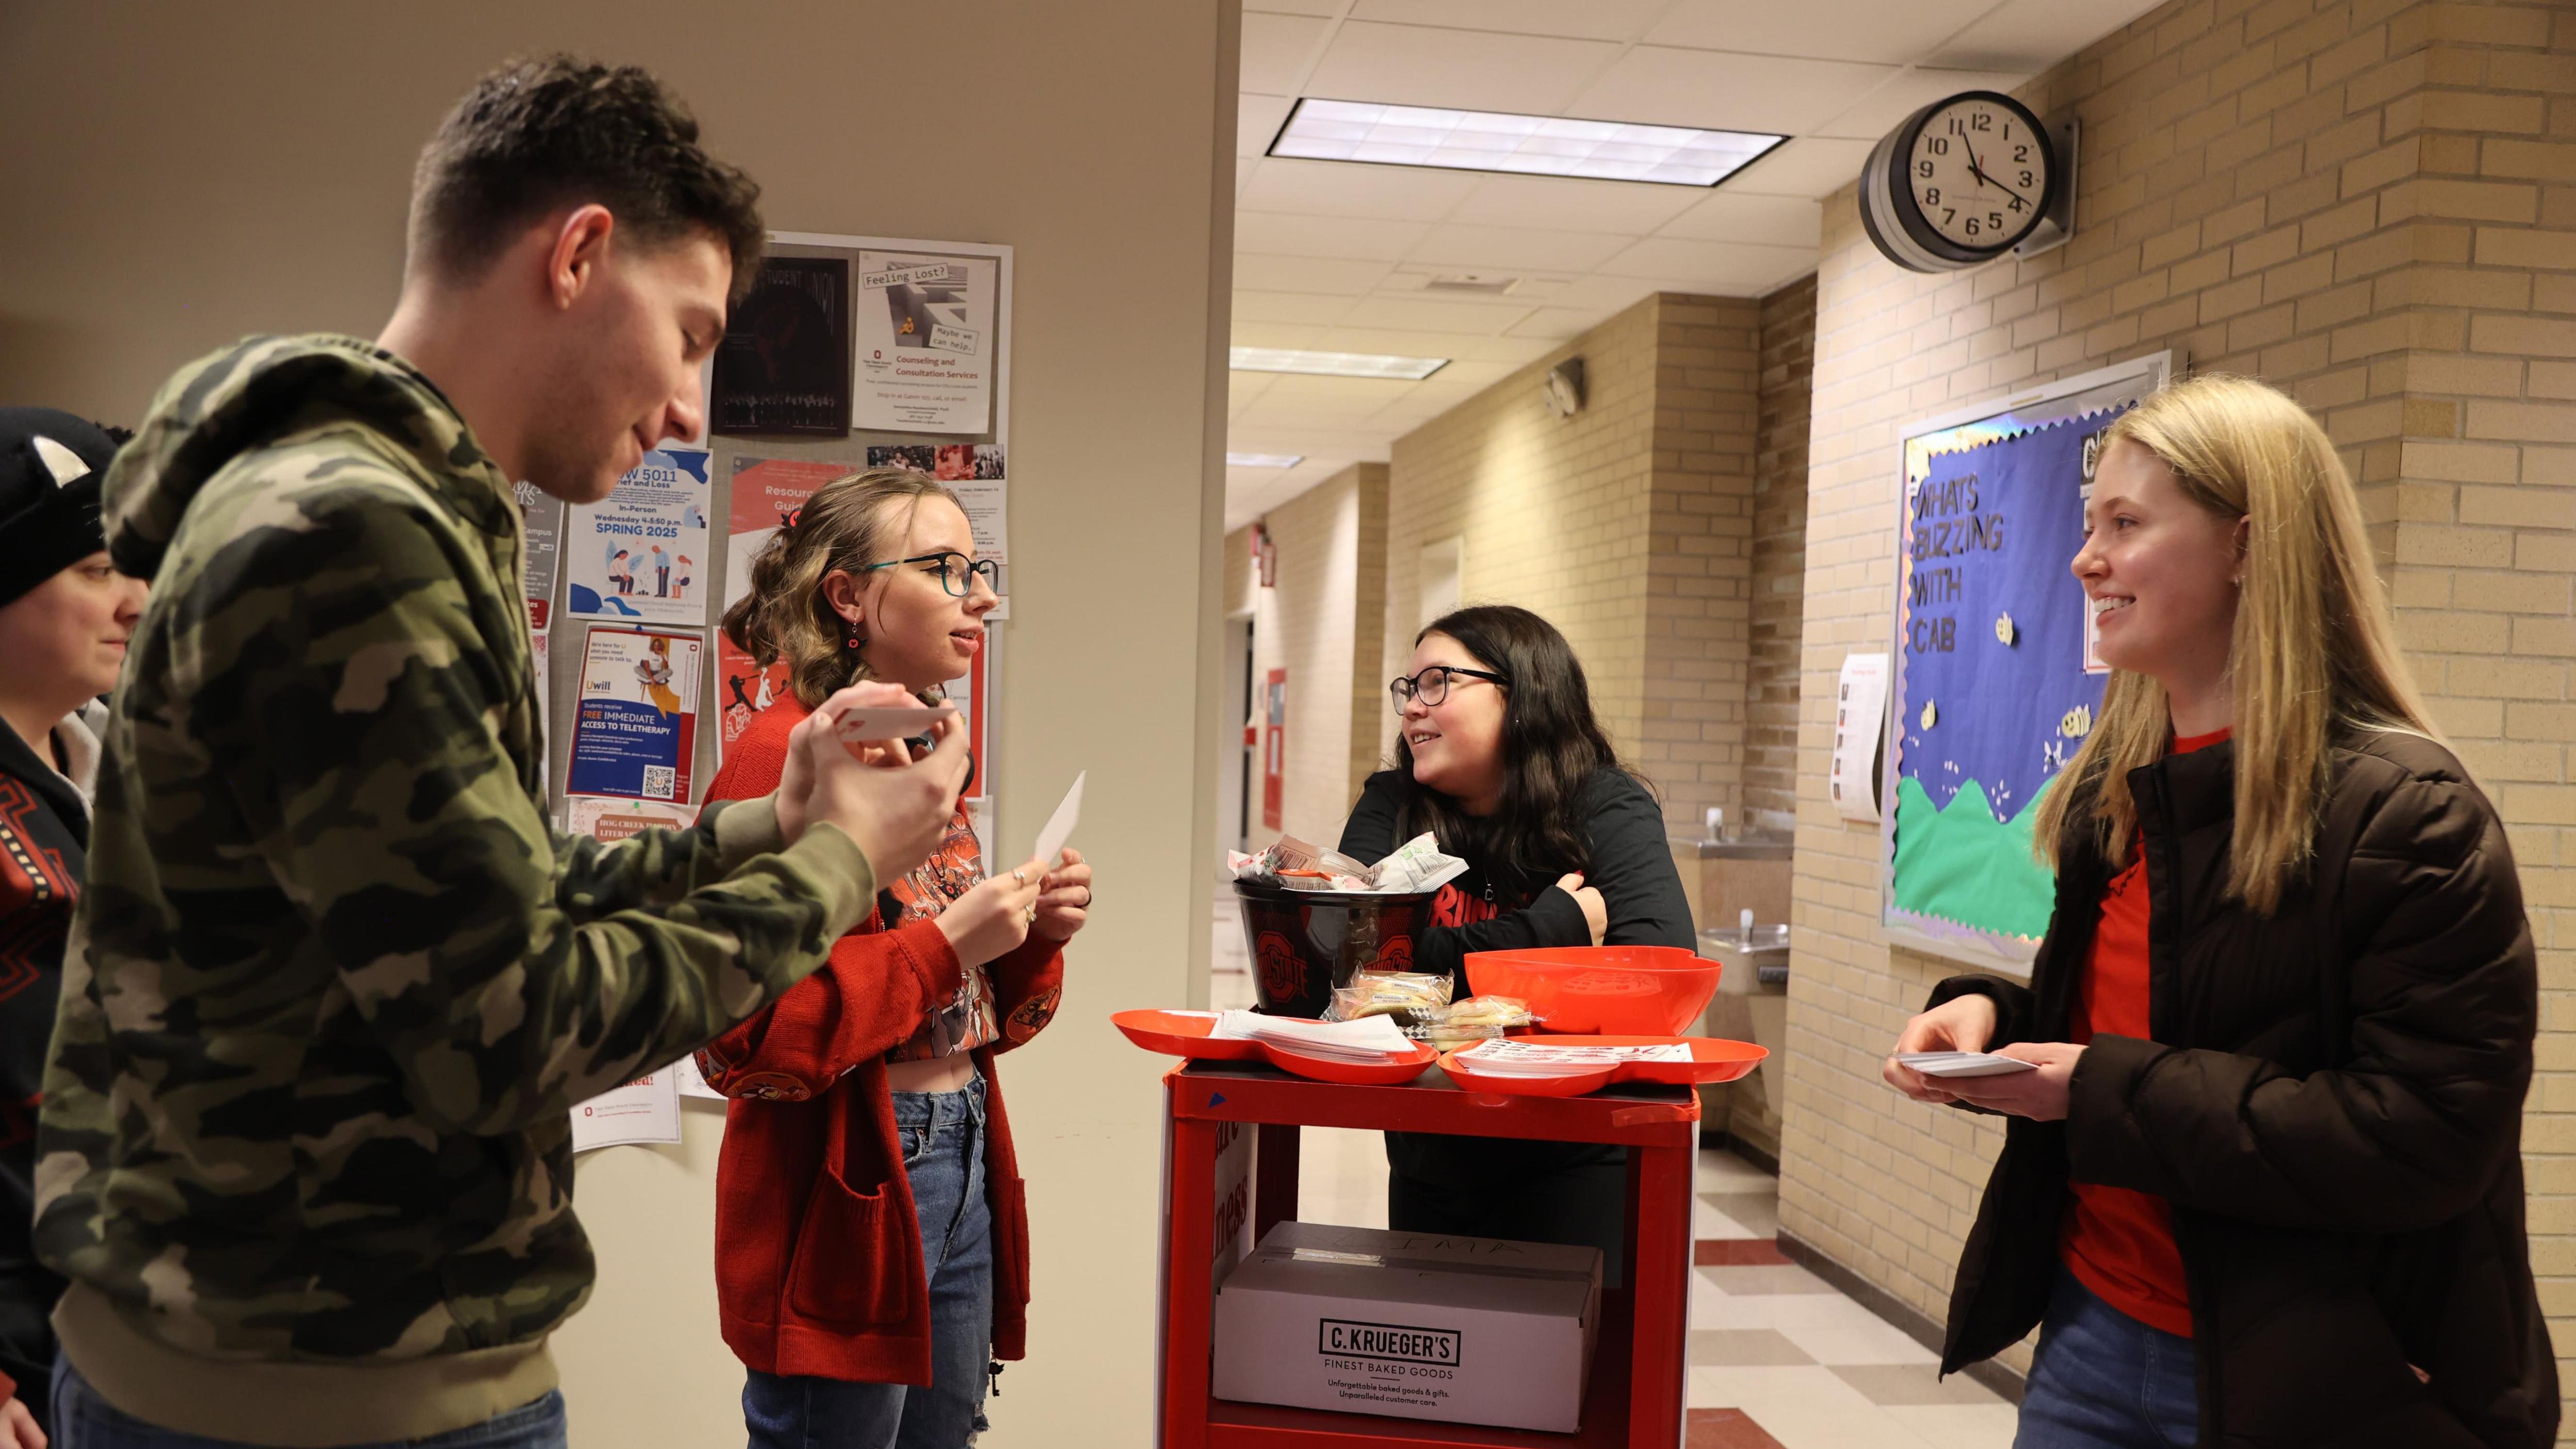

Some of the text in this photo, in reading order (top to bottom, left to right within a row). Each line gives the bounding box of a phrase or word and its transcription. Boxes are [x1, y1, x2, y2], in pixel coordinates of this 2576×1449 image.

[1950, 119, 1963, 136] 11
[1972, 114, 1991, 132] 12
[2004, 124, 2008, 140] 1
[1928, 137, 1948, 155] 10
[2014, 145, 2028, 163] 2
[1919, 161, 1934, 178] 9
[2018, 171, 2033, 188] 3
[1925, 188, 1940, 206] 8
[2007, 196, 2022, 213] 4
[1942, 208, 1956, 225] 7
[1988, 213, 2003, 230] 5
[1965, 218, 1980, 235] 6
[866, 267, 945, 285] Feeling Lost?
[937, 328, 959, 338] Maybe
[950, 341, 971, 351] help.
[897, 356, 939, 366] Counseling
[896, 368, 945, 378] Consultation
[643, 470, 677, 482] 5011
[765, 486, 814, 498] Resourc
[1916, 473, 1979, 520] WHATS
[619, 505, 657, 513] In-Person
[595, 514, 639, 524] Wednesday
[596, 523, 677, 538] SPRING 2025
[1915, 513, 2004, 561] BUZZING
[1911, 567, 1962, 607] WITH
[1913, 617, 1956, 654] CAB
[586, 680, 611, 690] Uwill
[582, 711, 655, 724] FREE IMMEDIATE
[620, 723, 671, 735] TELETHERAPY
[600, 819, 618, 827] HOG
[619, 820, 644, 829] CREEK
[1214, 1174, 1248, 1261] ness
[1325, 1359, 1453, 1379] FINEST BAKED GOODS
[1328, 1379, 1377, 1390] Unforgettable
[1379, 1383, 1400, 1393] baked
[1402, 1387, 1424, 1396] goods
[1433, 1389, 1450, 1398] gifts.
[1339, 1391, 1384, 1402] Unparalleled
[1386, 1395, 1418, 1405] customer
